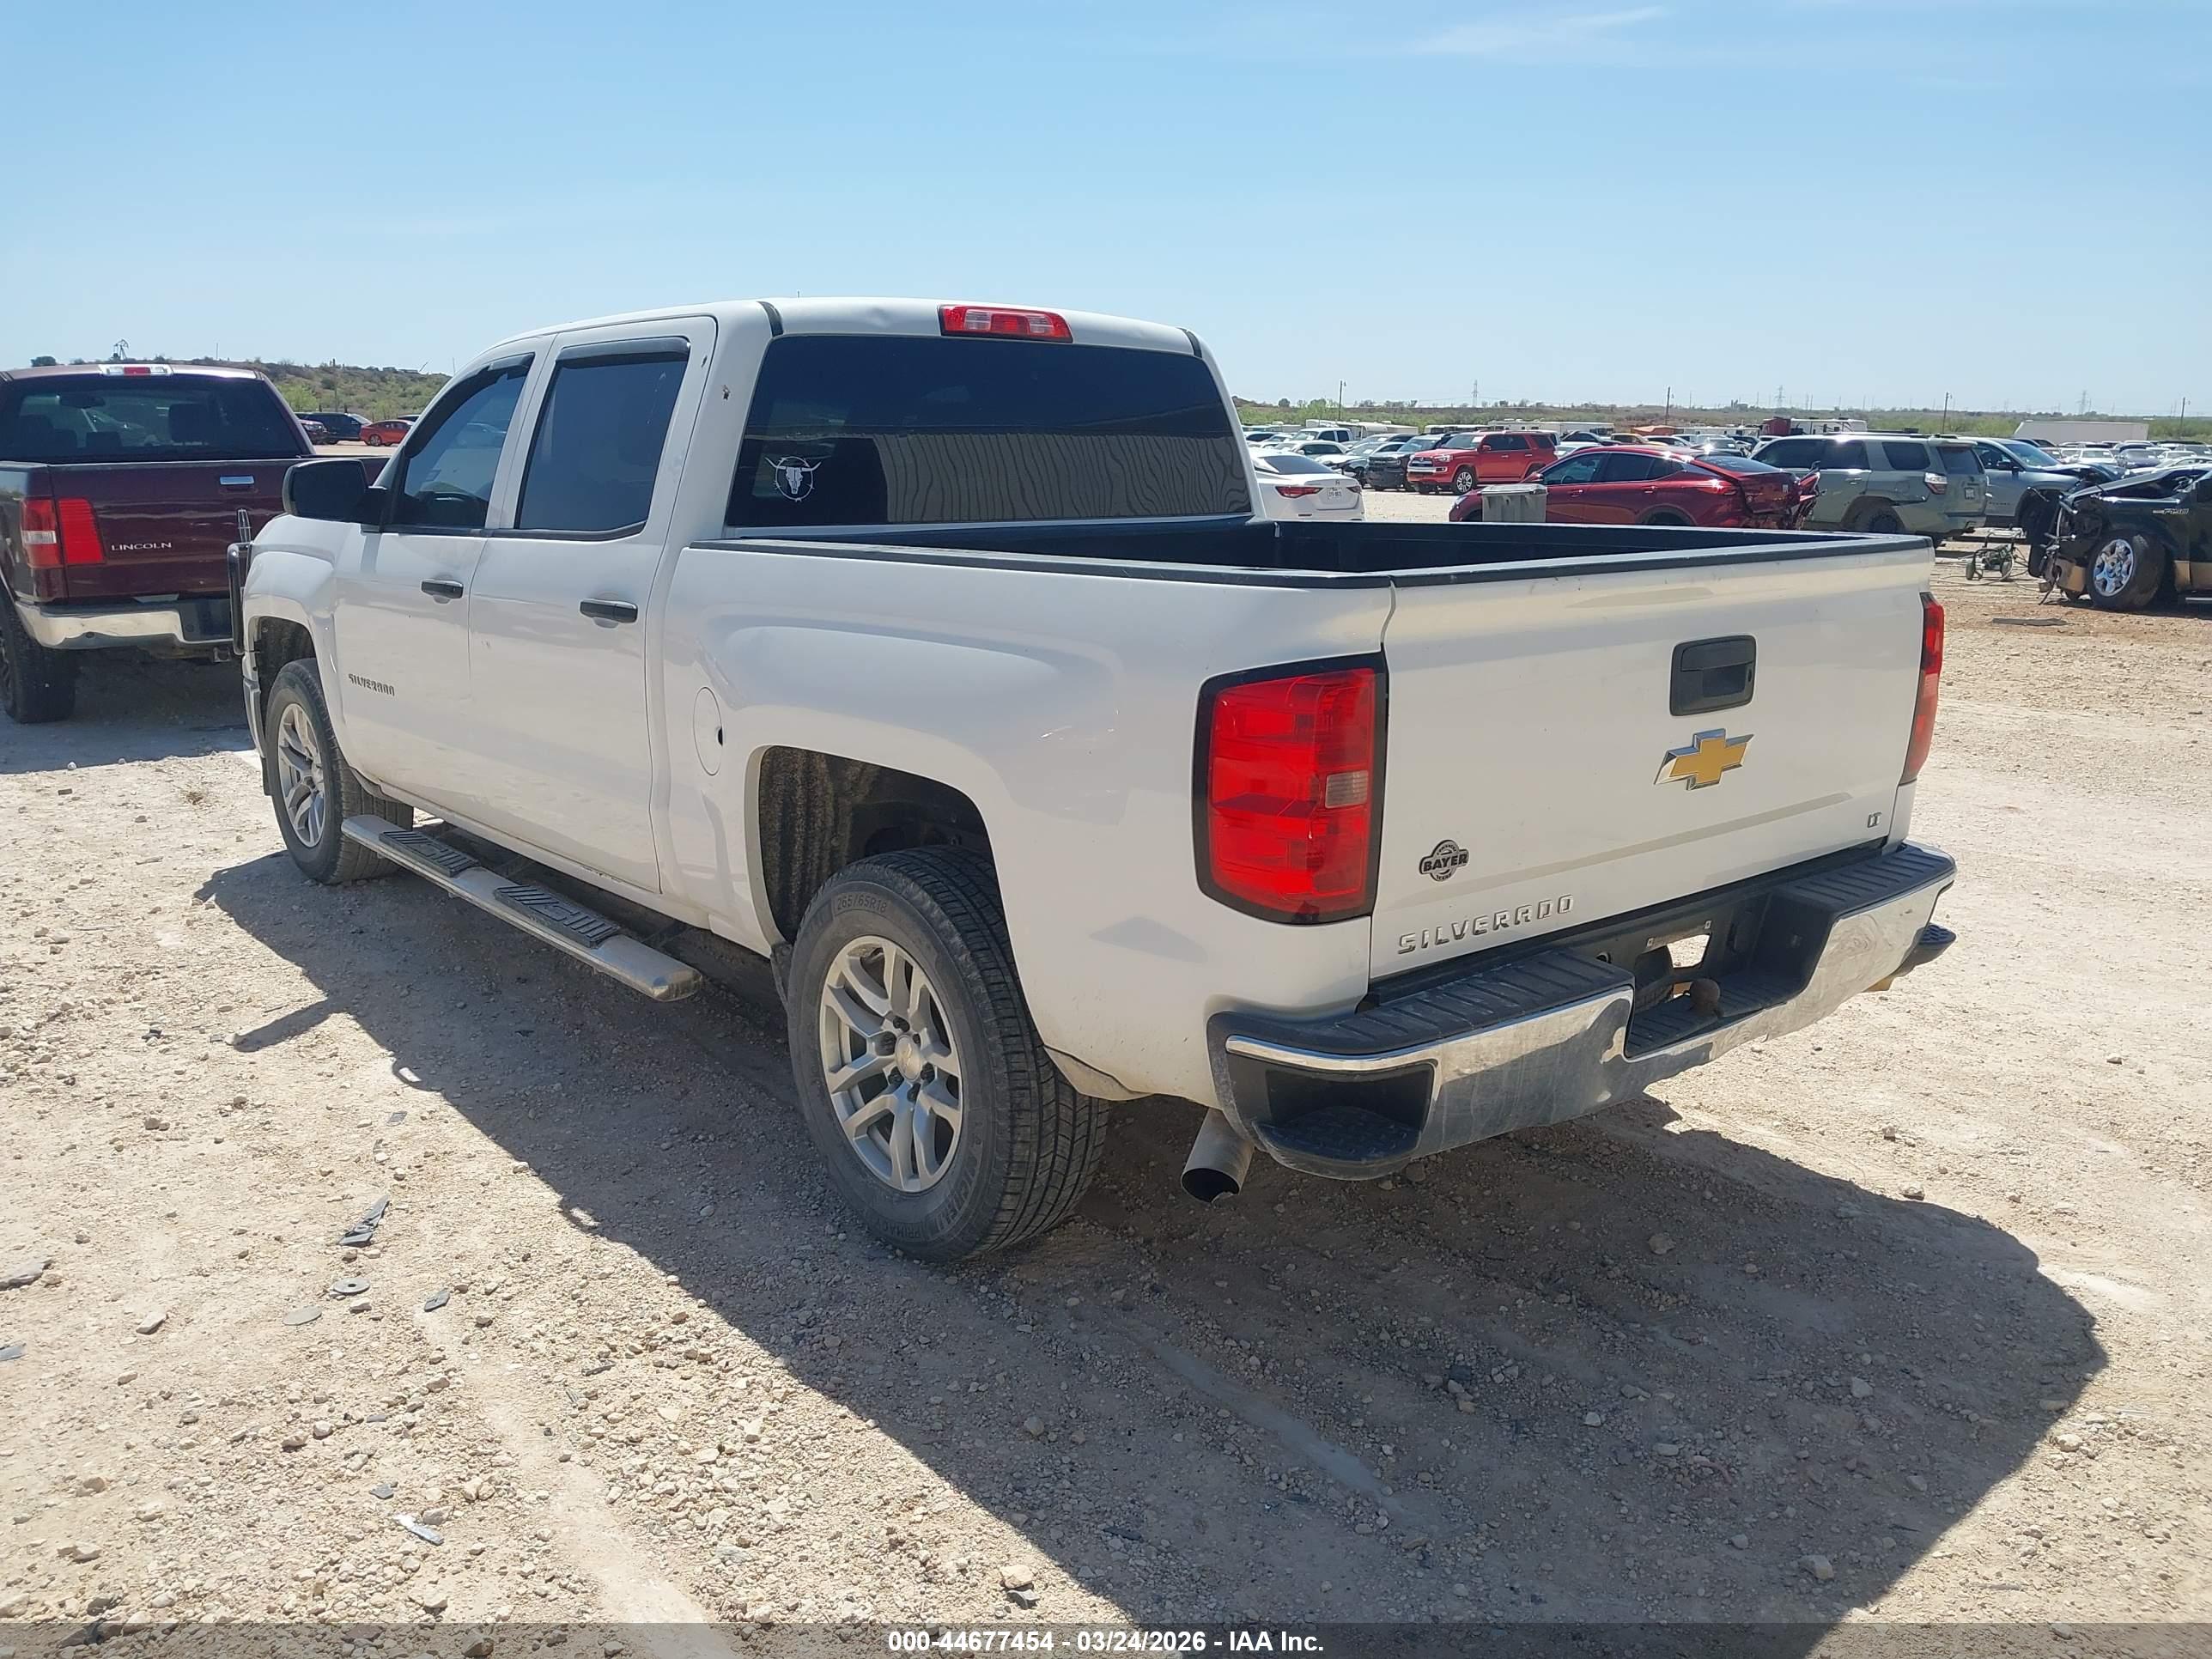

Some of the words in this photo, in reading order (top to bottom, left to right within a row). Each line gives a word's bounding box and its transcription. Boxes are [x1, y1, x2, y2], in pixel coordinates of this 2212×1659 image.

[111, 542, 172, 551] LINCOLN
[1867, 811, 1882, 828] LT
[1423, 853, 1468, 872] BAYER
[837, 894, 887, 913] 265/65R18
[1397, 893, 1575, 955] SILVERADO
